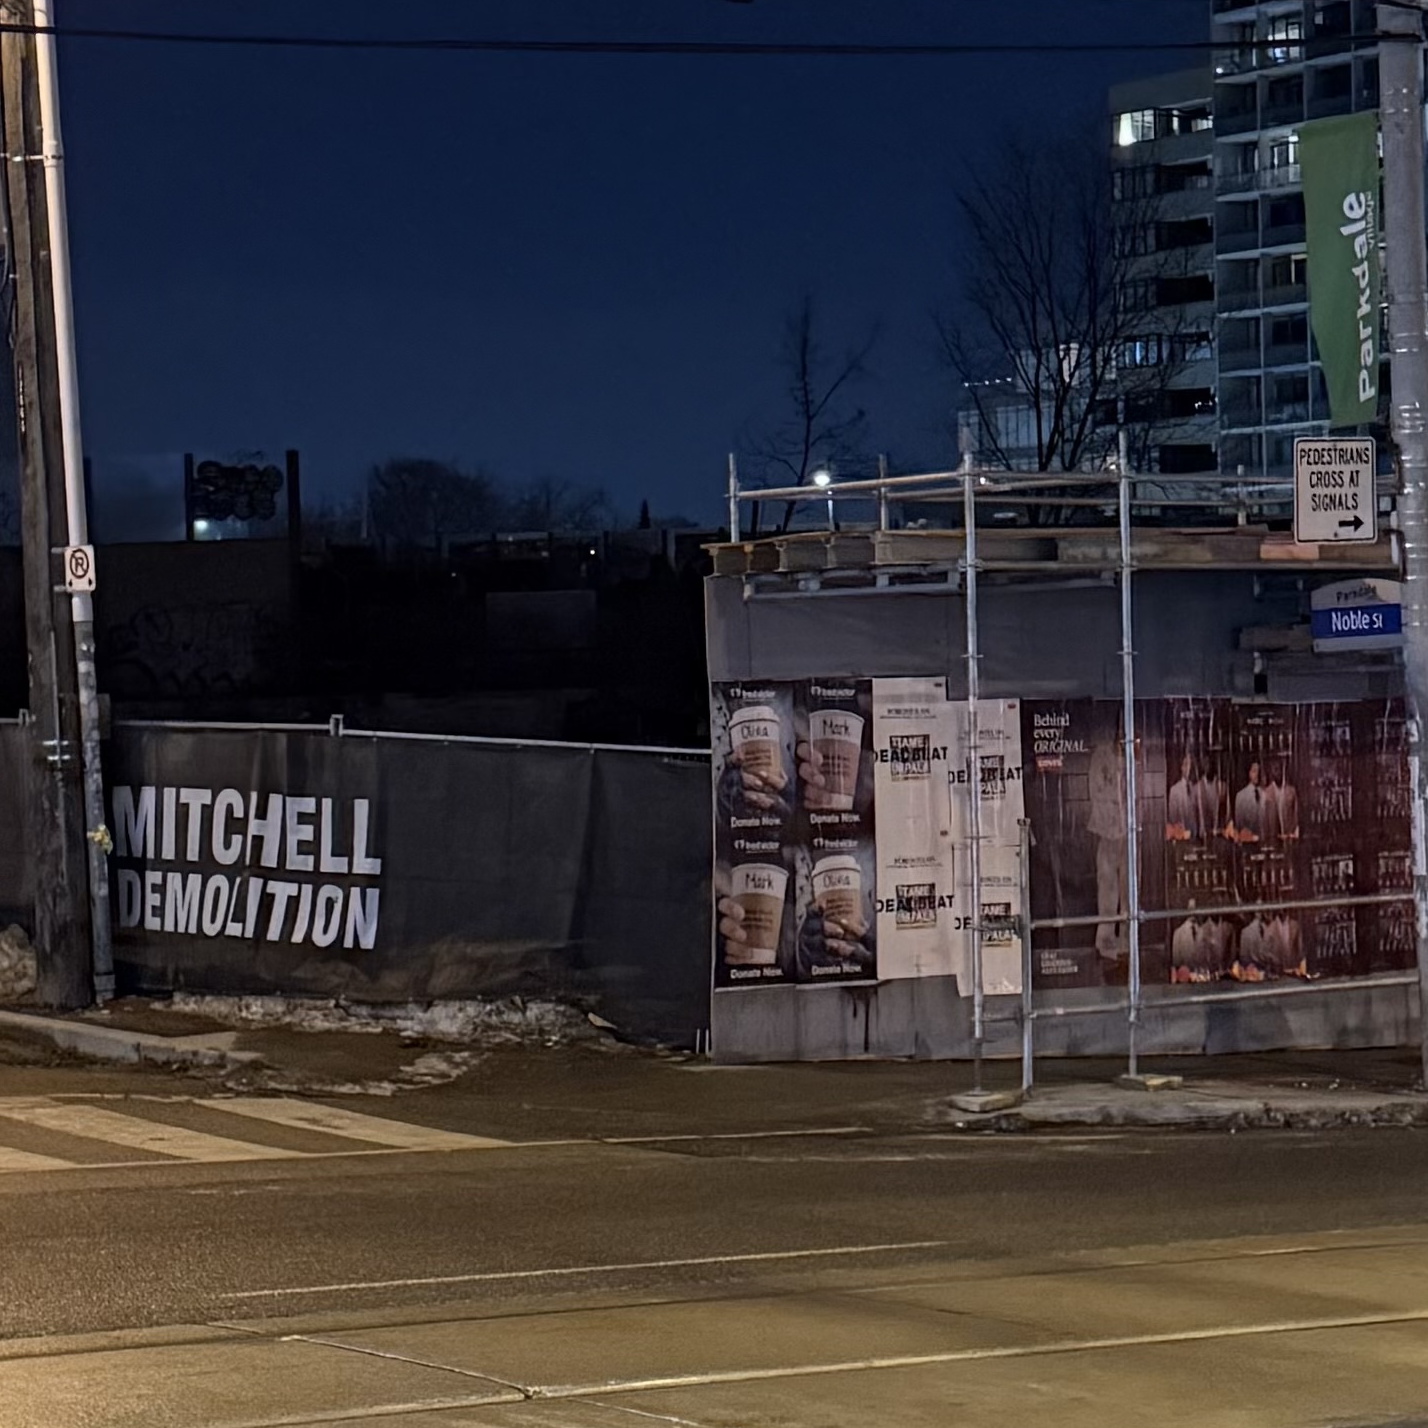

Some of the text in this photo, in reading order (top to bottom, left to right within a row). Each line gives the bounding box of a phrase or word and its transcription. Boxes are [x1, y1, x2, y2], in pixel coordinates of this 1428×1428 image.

[1340, 192, 1376, 403] Parkdale
[1300, 447, 1370, 466] PEDESTRIANS
[1309, 470, 1360, 489] CROSS AT
[1311, 493, 1358, 512] SIGNALS
[1331, 609, 1370, 633] Noble
[1034, 713, 1070, 727] Behind
[112, 784, 382, 876] MITCHELL
[117, 870, 381, 950] DEMOLITION
